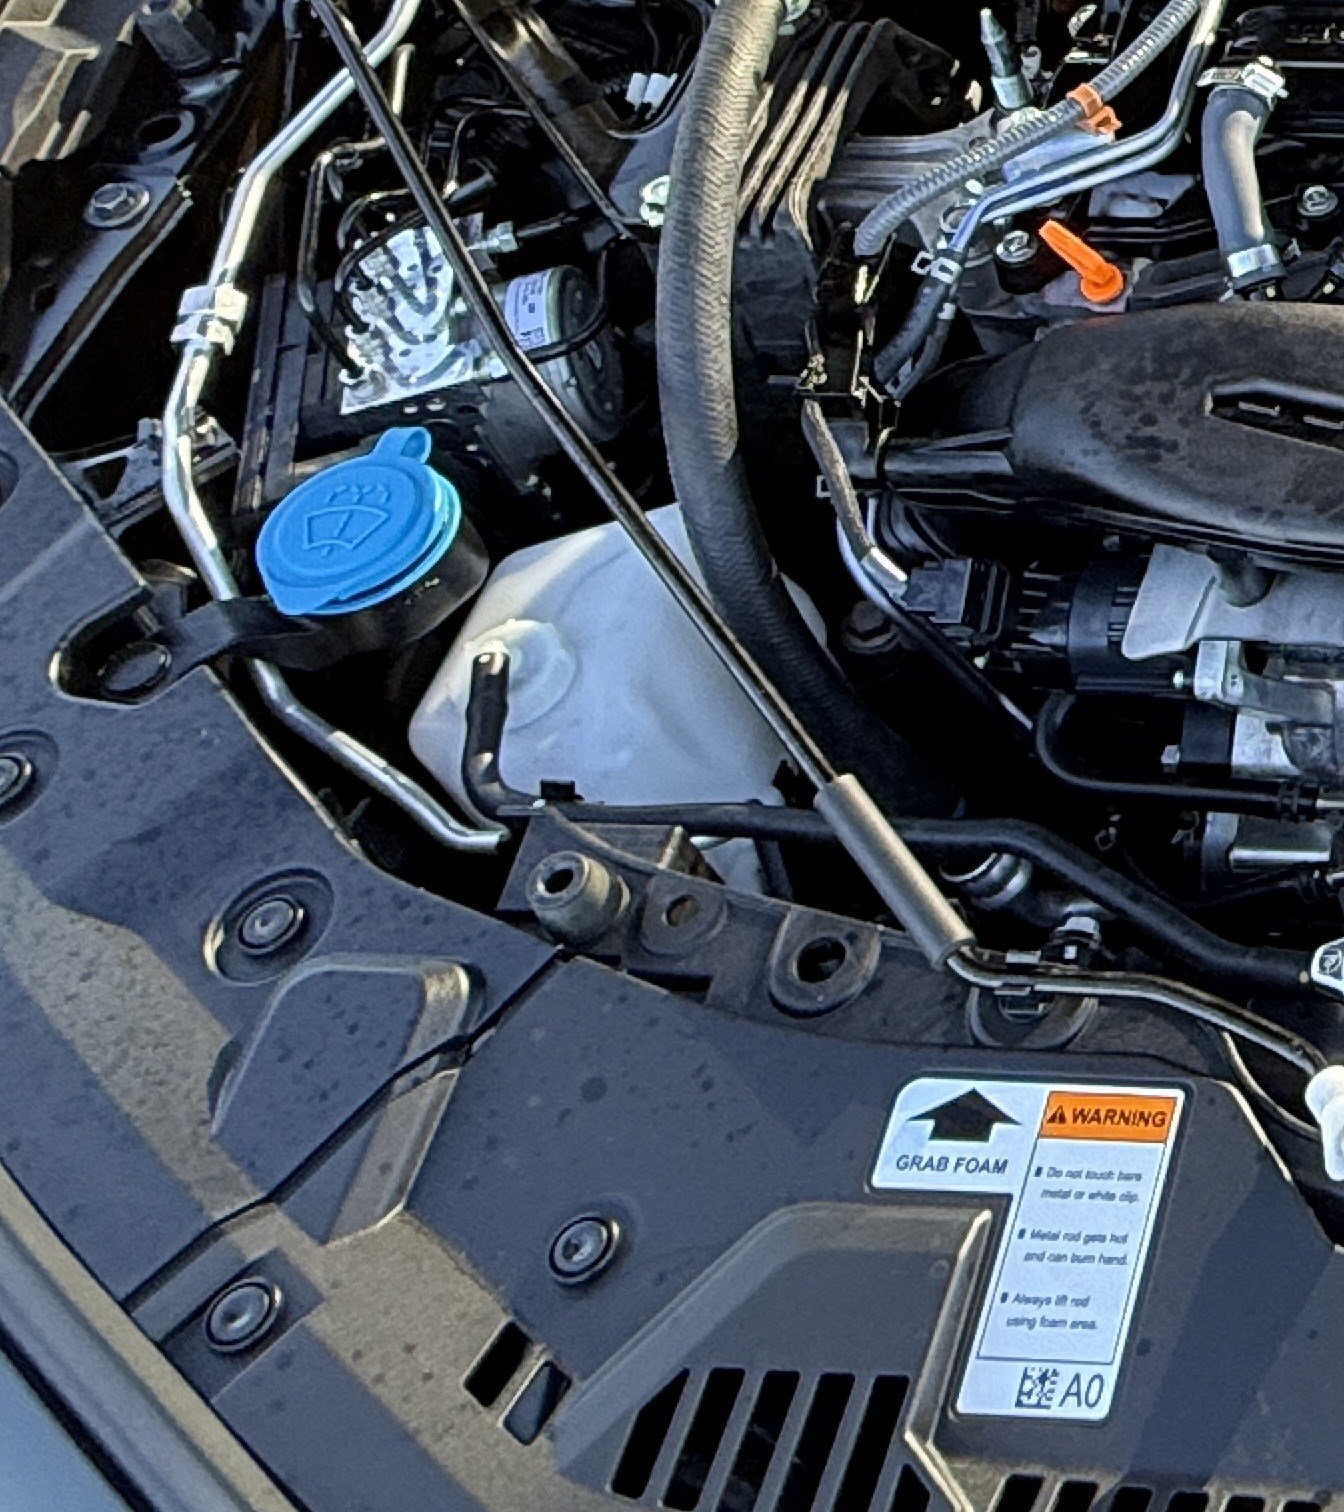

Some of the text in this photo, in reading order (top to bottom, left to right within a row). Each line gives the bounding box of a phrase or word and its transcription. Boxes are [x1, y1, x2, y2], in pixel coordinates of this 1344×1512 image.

[1072, 1107, 1167, 1128] WARNING
[896, 1154, 1009, 1174] GRAB FOAM
[1047, 1167, 1142, 1181] Do not touch bare
[1041, 1189, 1072, 1200] metal
[1074, 1191, 1085, 1199] or
[1088, 1190, 1116, 1201] white
[1031, 1229, 1128, 1245] Metal rod gets hot
[1024, 1251, 1046, 1262] and
[1047, 1253, 1067, 1262] can
[1071, 1252, 1095, 1263] burn
[1011, 1293, 1091, 1309] Always lift rod
[1007, 1317, 1037, 1331] using
[1039, 1315, 1067, 1327] foam
